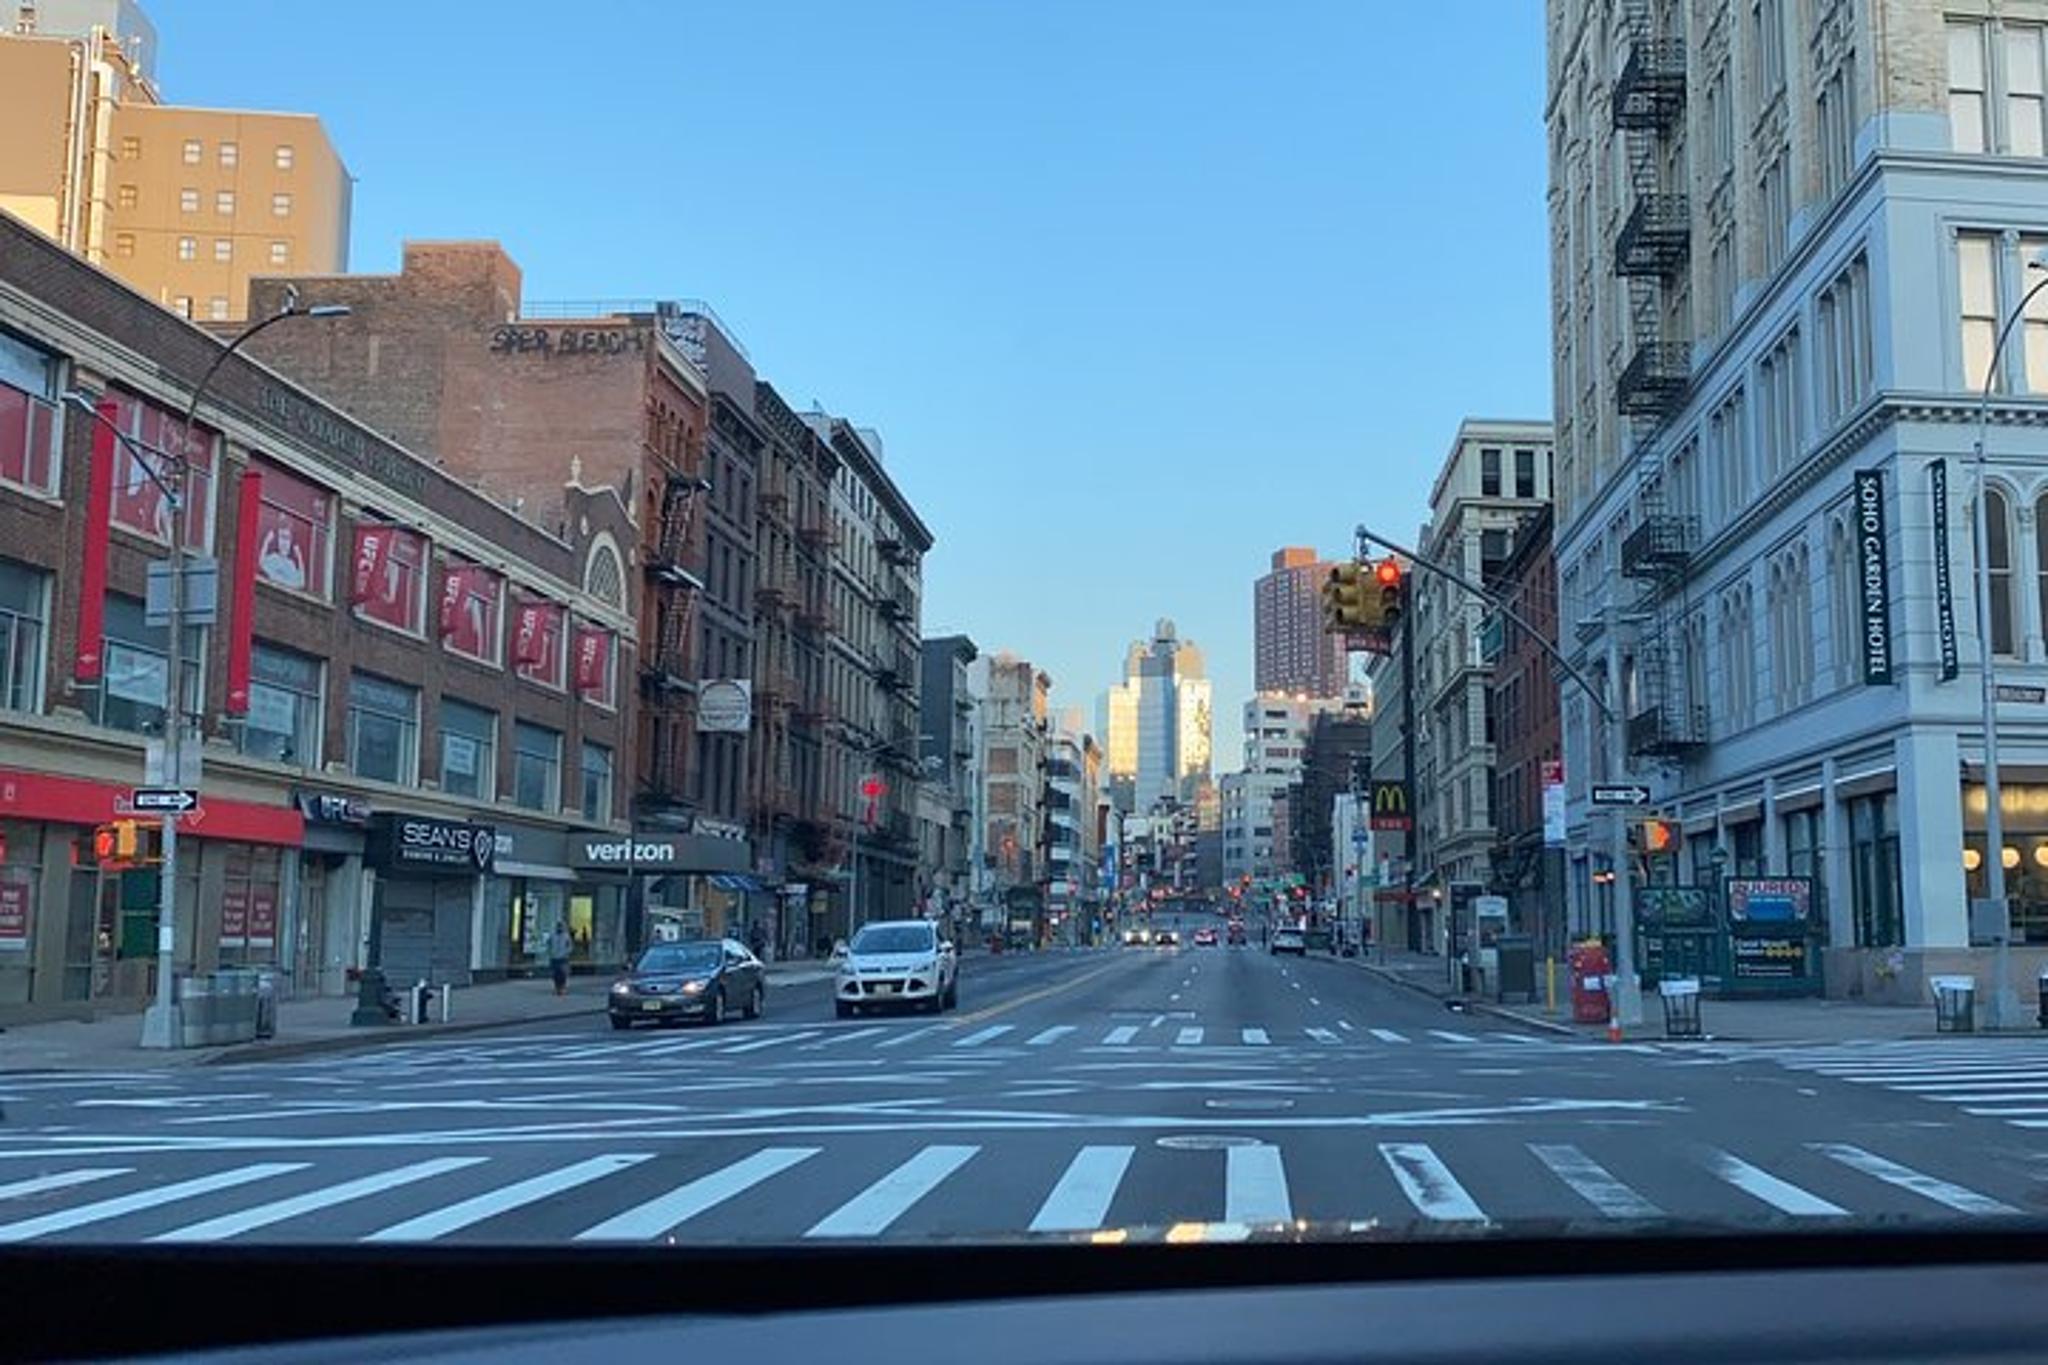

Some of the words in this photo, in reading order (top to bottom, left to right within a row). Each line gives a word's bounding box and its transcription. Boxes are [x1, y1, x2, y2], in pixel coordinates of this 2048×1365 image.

[1860, 476, 1879, 534] SOHO
[359, 536, 379, 572] UFC
[443, 576, 461, 606] UFC
[1863, 536, 1884, 613] GARDEN
[520, 609, 536, 639] UFC
[1941, 610, 1956, 668] HOTEL
[581, 637, 597, 665] UFC
[1867, 617, 1888, 675] HOTEL
[321, 795, 350, 821] UFC
[586, 838, 675, 861] verizon
